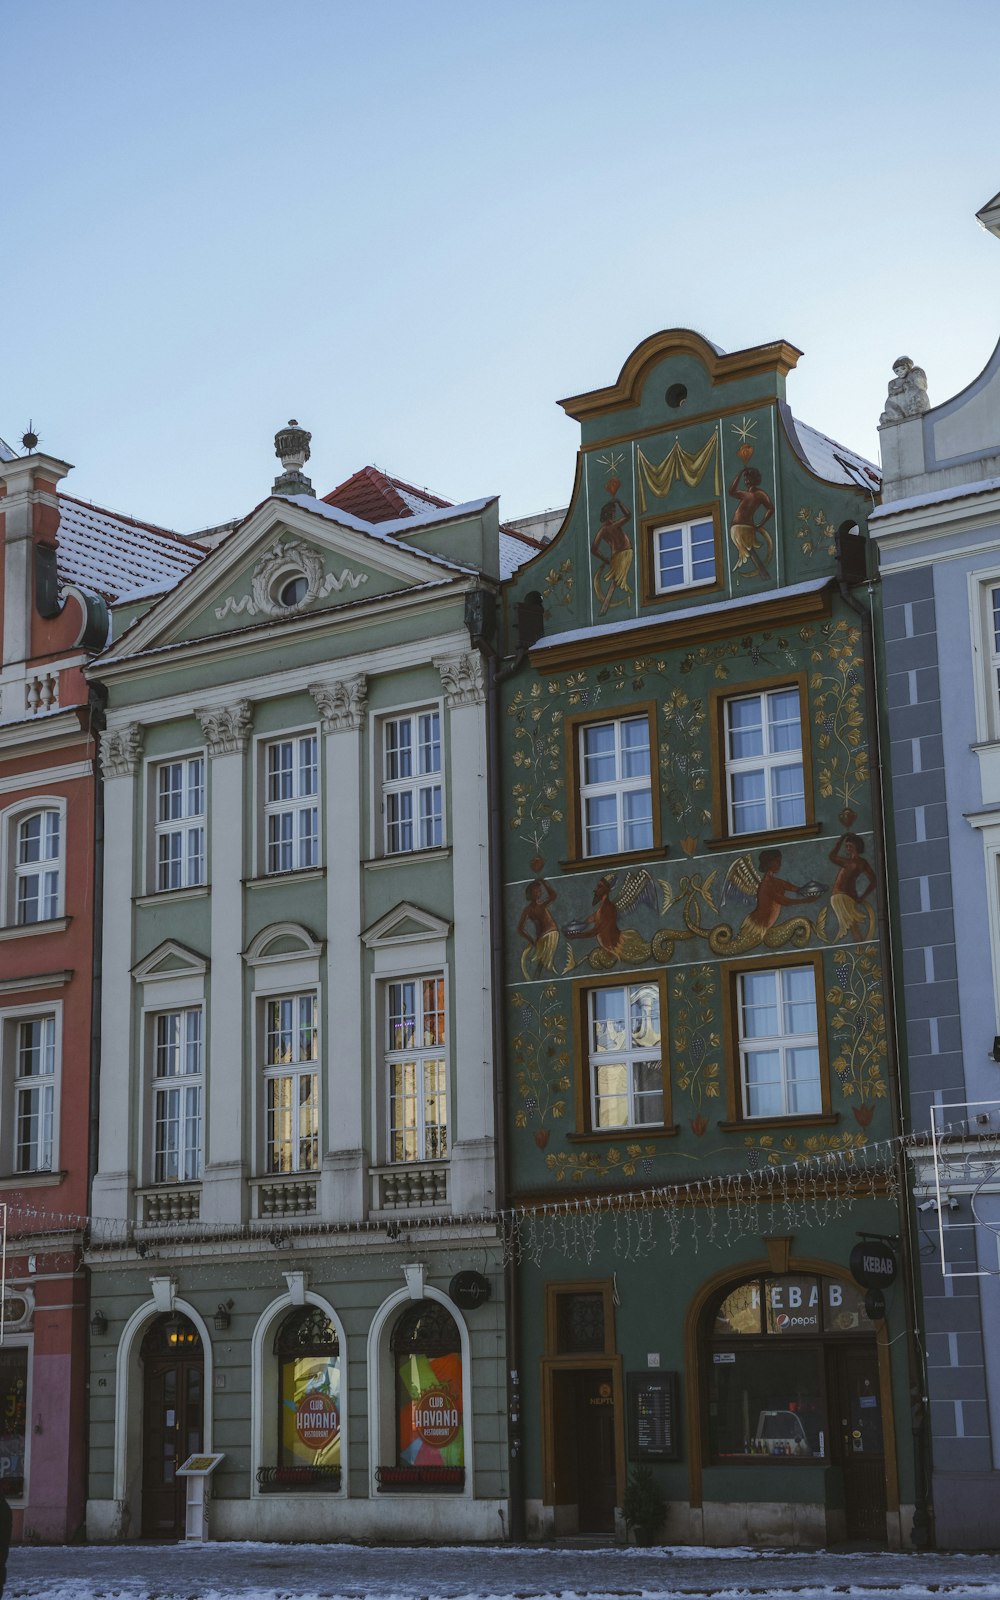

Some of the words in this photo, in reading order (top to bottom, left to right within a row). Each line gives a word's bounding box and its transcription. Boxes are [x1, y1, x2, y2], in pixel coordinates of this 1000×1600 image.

[863, 1256, 893, 1274] KEBAB
[790, 1315, 817, 1326] pepsi
[309, 1400, 324, 1411] CLUB
[429, 1397, 444, 1408] CLUB
[296, 1411, 337, 1430] HAVANA
[415, 1409, 458, 1428] HAVANA
